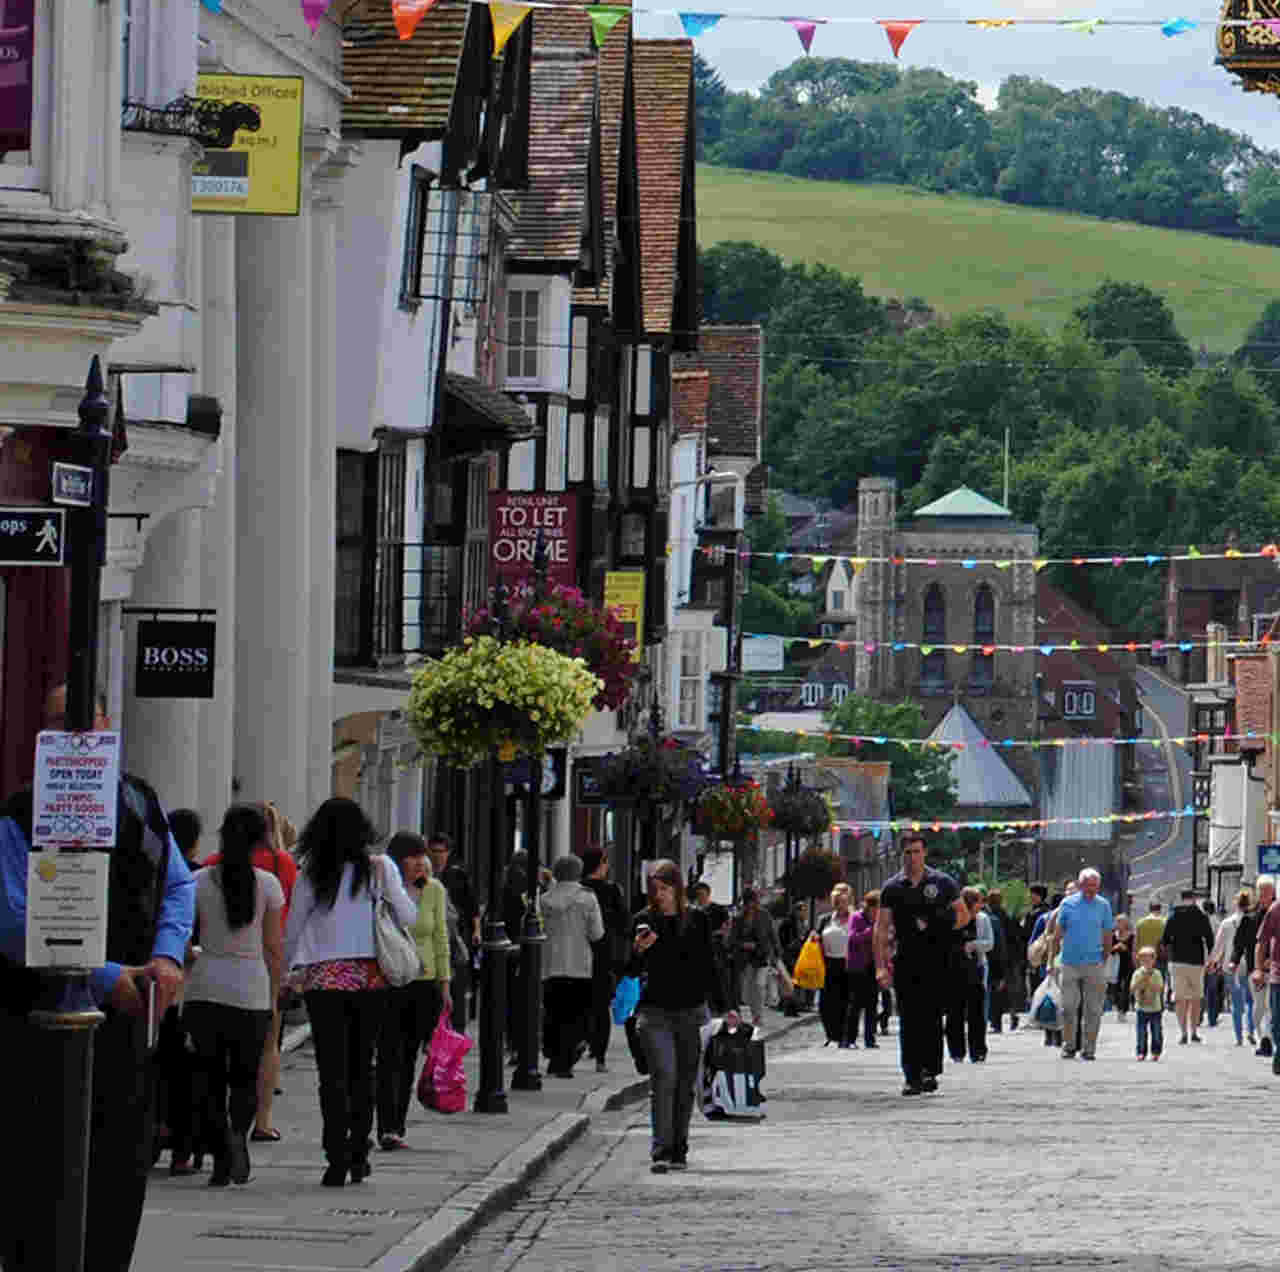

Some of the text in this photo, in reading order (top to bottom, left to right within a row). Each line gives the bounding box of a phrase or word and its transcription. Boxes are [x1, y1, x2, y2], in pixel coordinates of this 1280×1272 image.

[497, 507, 568, 527] TO LET
[143, 647, 208, 665] BOSS
